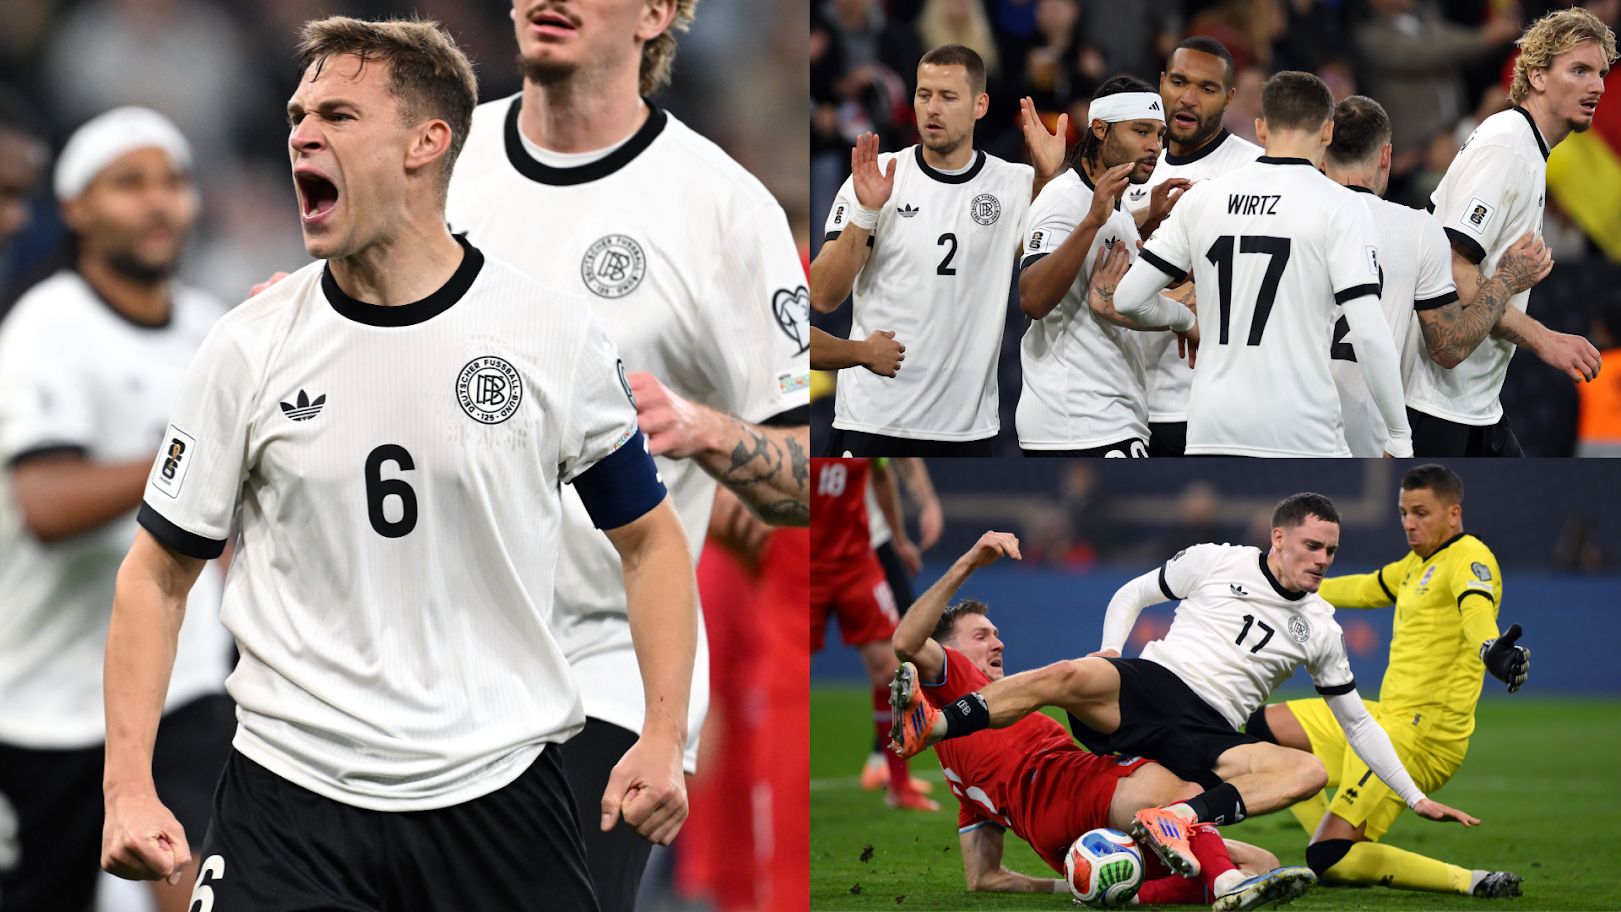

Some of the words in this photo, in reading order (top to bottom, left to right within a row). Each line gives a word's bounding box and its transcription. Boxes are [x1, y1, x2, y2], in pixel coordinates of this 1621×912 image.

[1227, 194, 1281, 215] WIRTZ
[936, 232, 958, 276] 2
[1205, 235, 1292, 347] 17
[459, 361, 481, 414] DEUTSCHER
[364, 443, 418, 539] 6
[818, 462, 848, 497] 18
[1235, 614, 1276, 654] 17
[188, 854, 225, 912] 6
